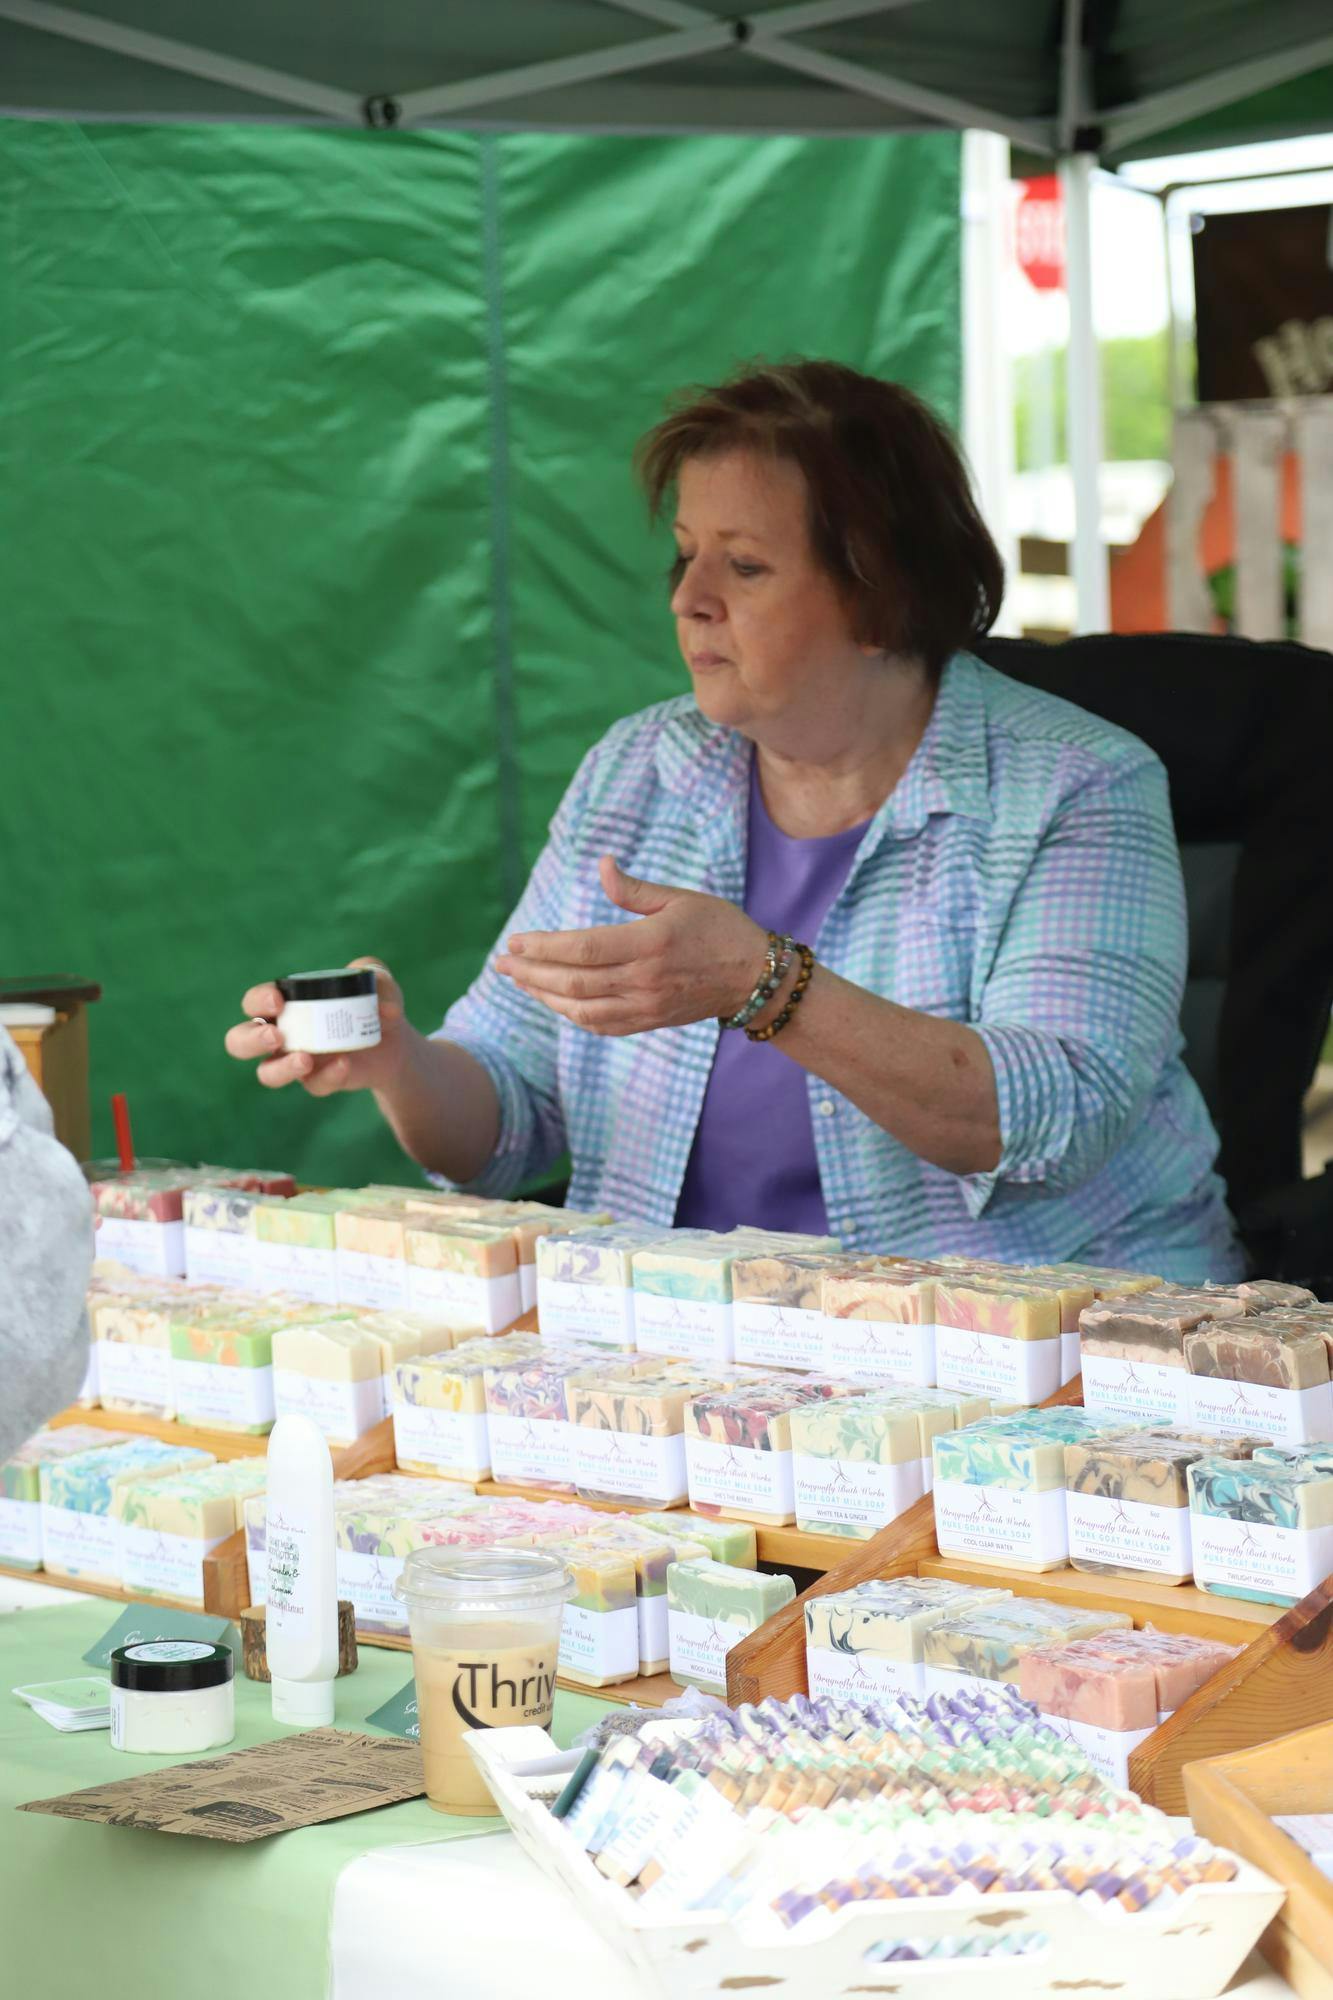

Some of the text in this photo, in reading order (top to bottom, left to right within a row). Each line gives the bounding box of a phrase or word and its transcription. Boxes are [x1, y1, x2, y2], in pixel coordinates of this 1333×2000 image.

[1089, 1377, 1177, 1399] Dragonfly Bath Works
[1090, 1390, 1177, 1409] PURE GOAT MILK SOAP
[1195, 1399, 1287, 1423] Dragonfly Bath Works
[1196, 1411, 1288, 1433] PURE GOAT MILK SOAP
[797, 1479, 885, 1498] Dragonfly Bath Works
[798, 1492, 885, 1510] PURE GOAT MILK SOAP
[849, 1512, 868, 1521] GINGER
[940, 1506, 1032, 1529] Dragonfly Bath Works
[942, 1519, 1032, 1539] PURE GOAT MILK SOAP
[1073, 1516, 1171, 1541] Dragonfly Bath Works
[963, 1537, 1013, 1551] COOL CLEAR WATER
[1075, 1529, 1171, 1552] PURE GOAT MILK SOAP
[1085, 1546, 1115, 1558] PATCHOULI
[1122, 1553, 1162, 1566] SANDALWOOD
[1201, 1539, 1296, 1564] Dragonfly Bath Works
[1203, 1554, 1297, 1575] PURE GOAT MILK SOAP
[1227, 1572, 1274, 1586] TWILIGHT WOODS
[575, 1628, 595, 1643] Works
[676, 1633, 710, 1651] Dragonfly
[577, 1642, 596, 1654] SOAP
[677, 1646, 694, 1656] PURE
[697, 1650, 714, 1661] GOAT
[690, 1664, 705, 1673] WOOD
[813, 1672, 854, 1690] Dragonfly
[856, 1680, 878, 1692] Bath
[815, 1686, 834, 1697] PURE
[839, 1690, 859, 1700] GOAT
[523, 1703, 546, 1718] credit
